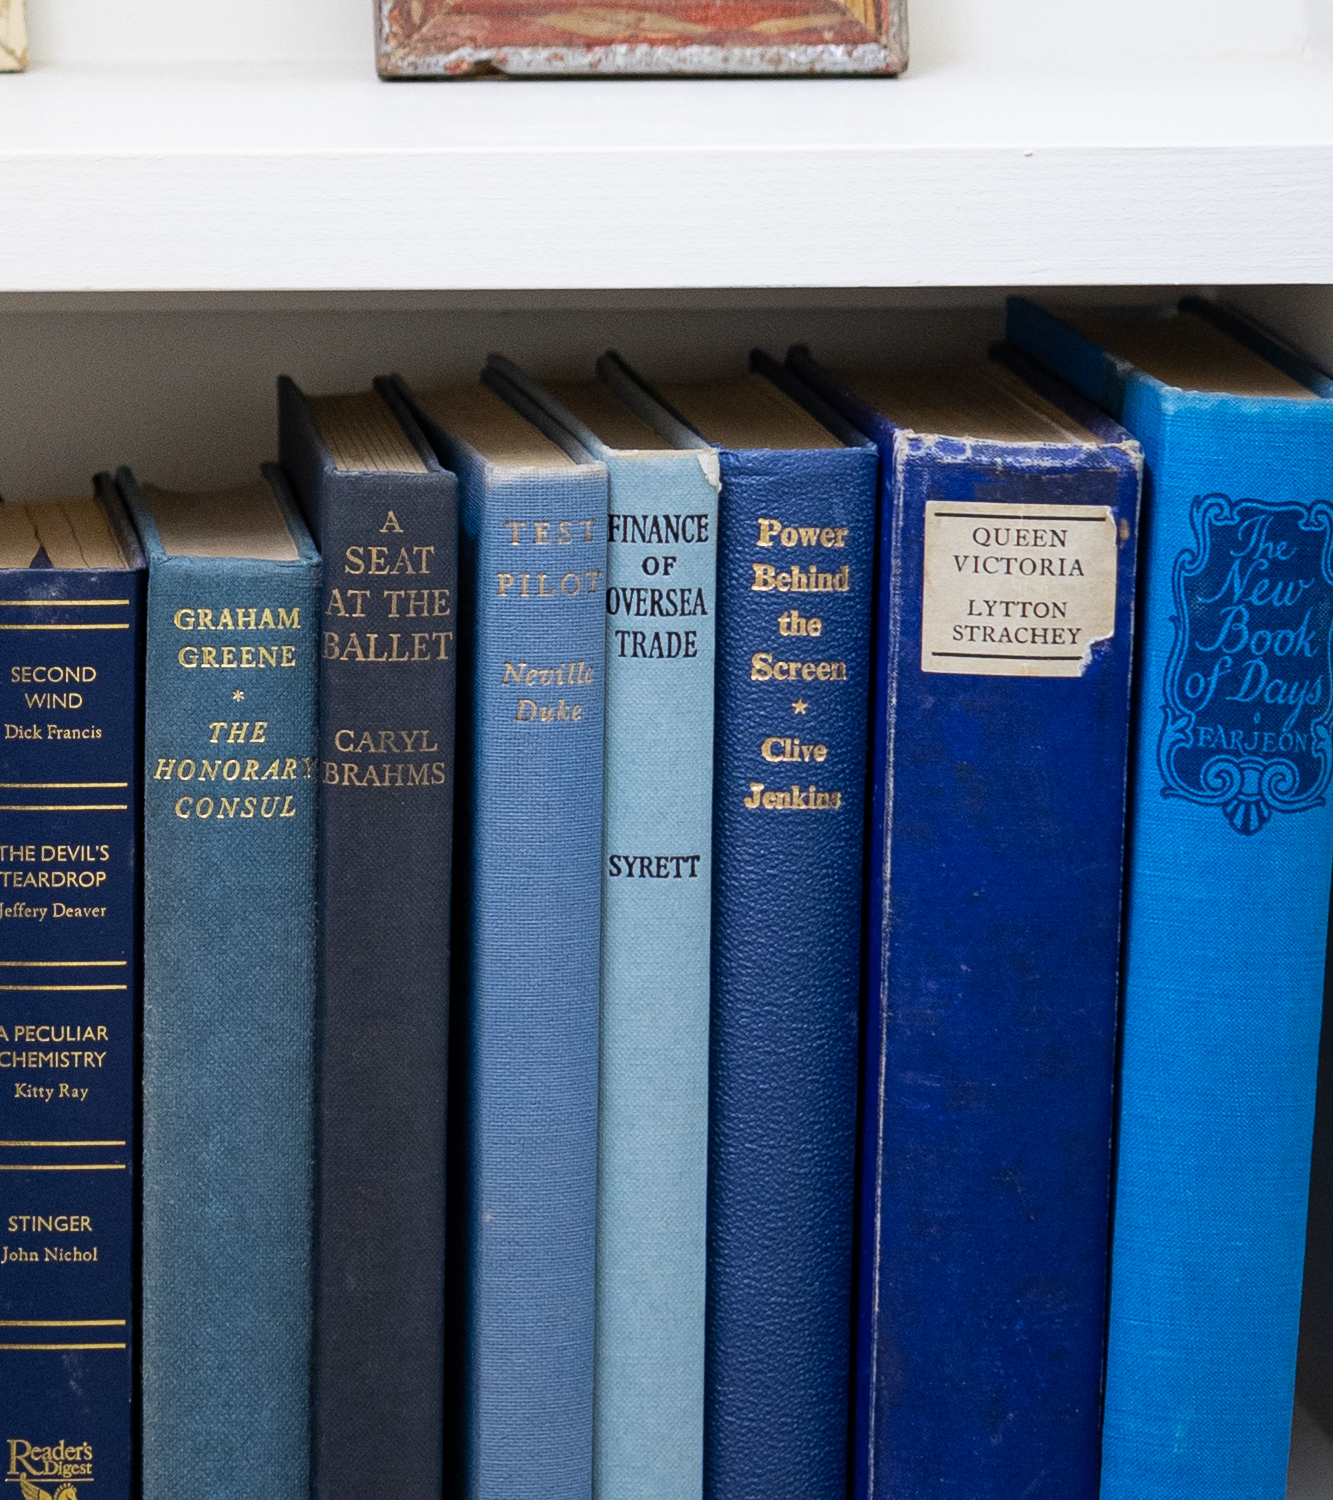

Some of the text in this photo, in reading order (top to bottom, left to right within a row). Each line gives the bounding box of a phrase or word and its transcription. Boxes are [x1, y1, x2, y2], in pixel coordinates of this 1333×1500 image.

[755, 518, 849, 549] Power
[971, 526, 1068, 548] QUEEN
[1228, 514, 1299, 561] The
[344, 544, 435, 576] SEAT
[952, 554, 1086, 578] VICTORIA
[751, 562, 851, 593] Behind
[1205, 558, 1314, 609] New
[327, 588, 451, 619] AT THE
[966, 599, 1068, 619] LYTTON
[173, 608, 301, 631] GRAHAM
[1194, 604, 1318, 660] Book
[322, 631, 454, 663] BALLET
[615, 630, 698, 660] TRADE
[951, 624, 1082, 646] STRACHEY
[177, 645, 297, 669] GREENE
[750, 652, 848, 682] Screen
[10, 666, 97, 684] SECOND
[24, 692, 83, 709] WIND
[4, 723, 103, 741] Dick Francis
[334, 729, 438, 755] CARYL
[760, 736, 828, 763] Clive
[322, 761, 447, 788] BRAHMS
[174, 796, 297, 820] CONSUL
[744, 783, 842, 811] Jenkins
[0, 871, 107, 888] TEARDROP
[608, 854, 701, 881] SYRETT
[14, 1026, 109, 1042] PECULIAR
[7, 1216, 93, 1233] STINGER
[1, 1246, 99, 1264] John Nichol
